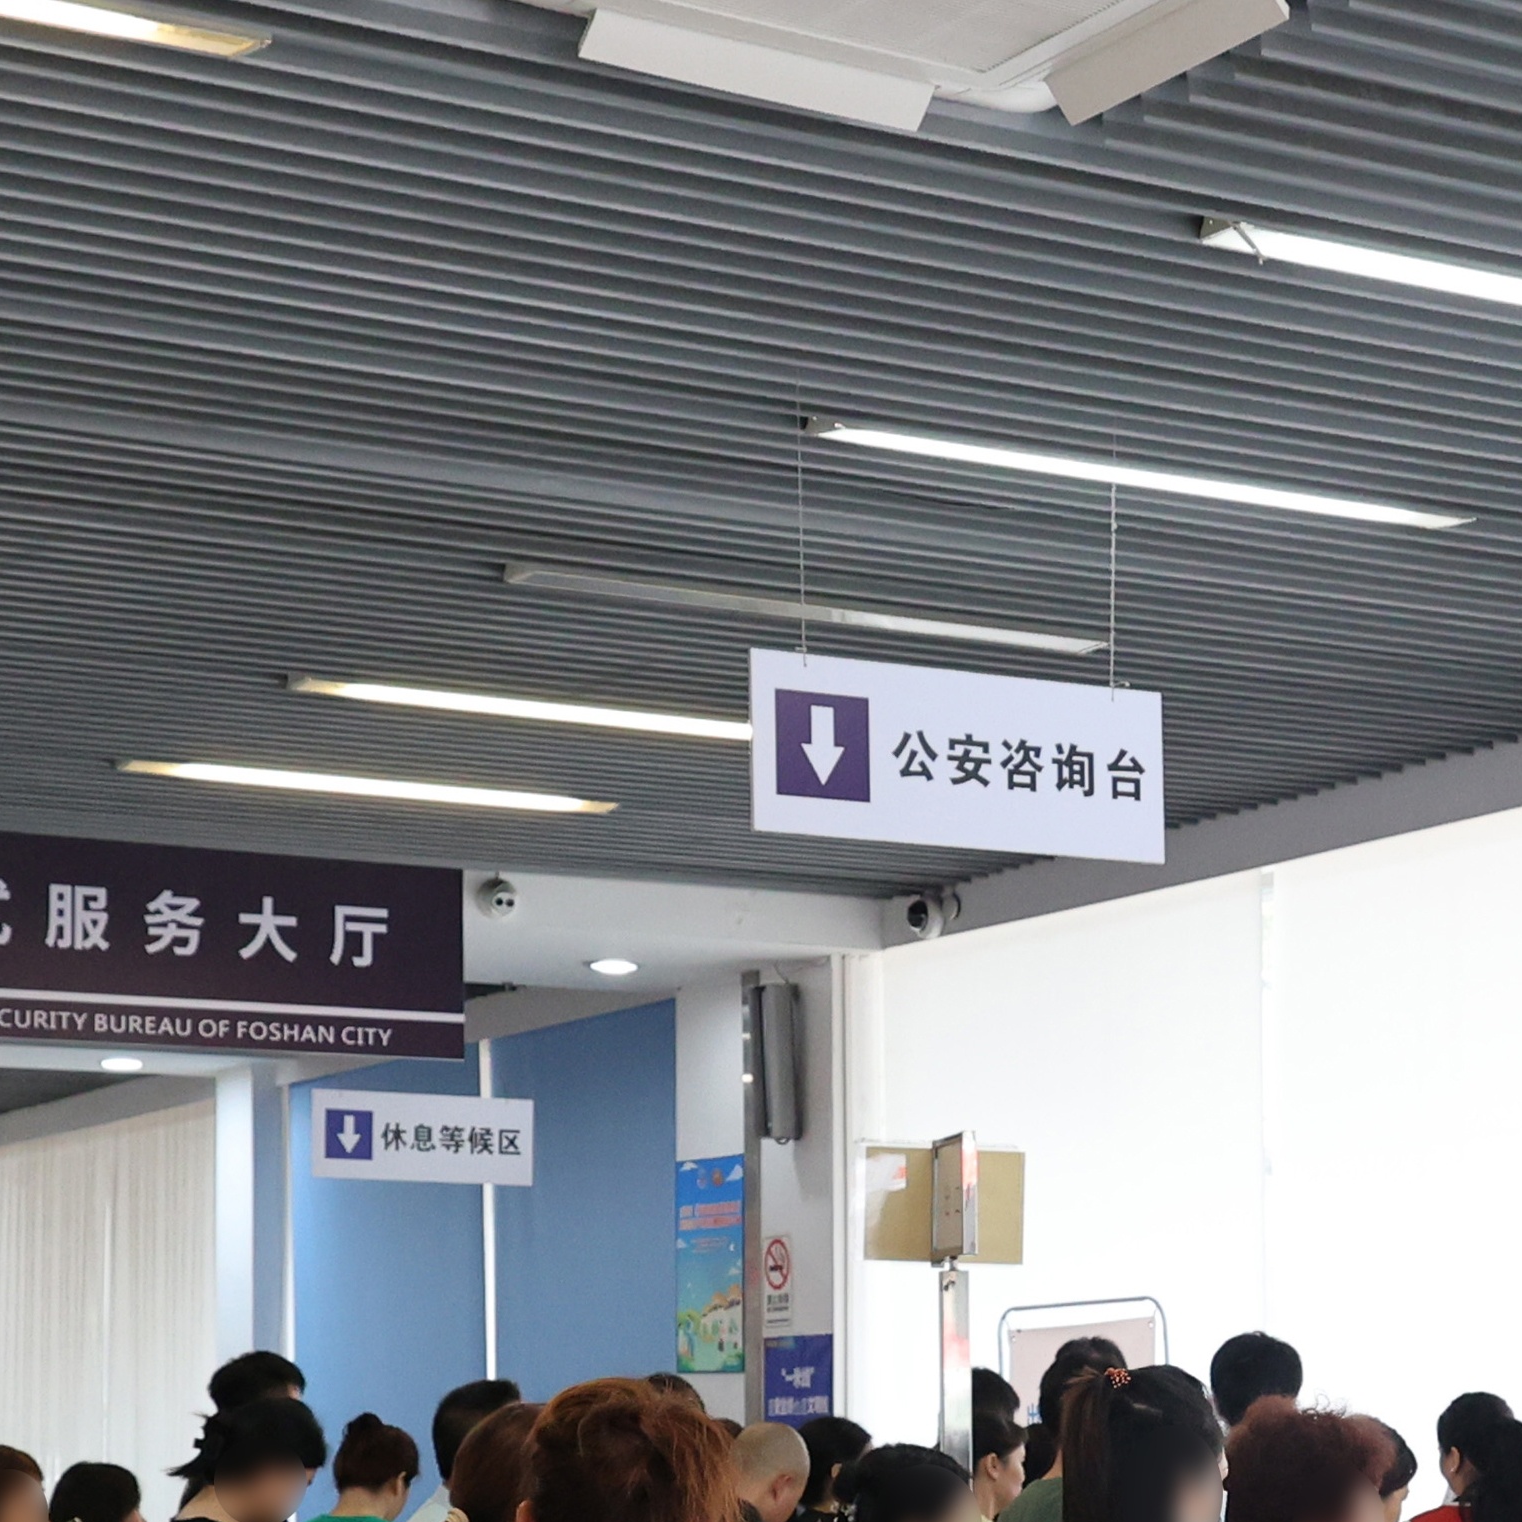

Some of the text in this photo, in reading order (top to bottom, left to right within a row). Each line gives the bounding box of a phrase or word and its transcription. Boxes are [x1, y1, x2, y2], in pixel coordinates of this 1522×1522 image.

[891, 730, 1146, 803] 公安咨询台
[94, 1013, 192, 1037] BUREAU
[198, 1018, 230, 1039] OF
[236, 1020, 335, 1044] FOSHAN
[340, 1026, 392, 1047] CITY
[380, 1122, 521, 1157] 休息等候区
